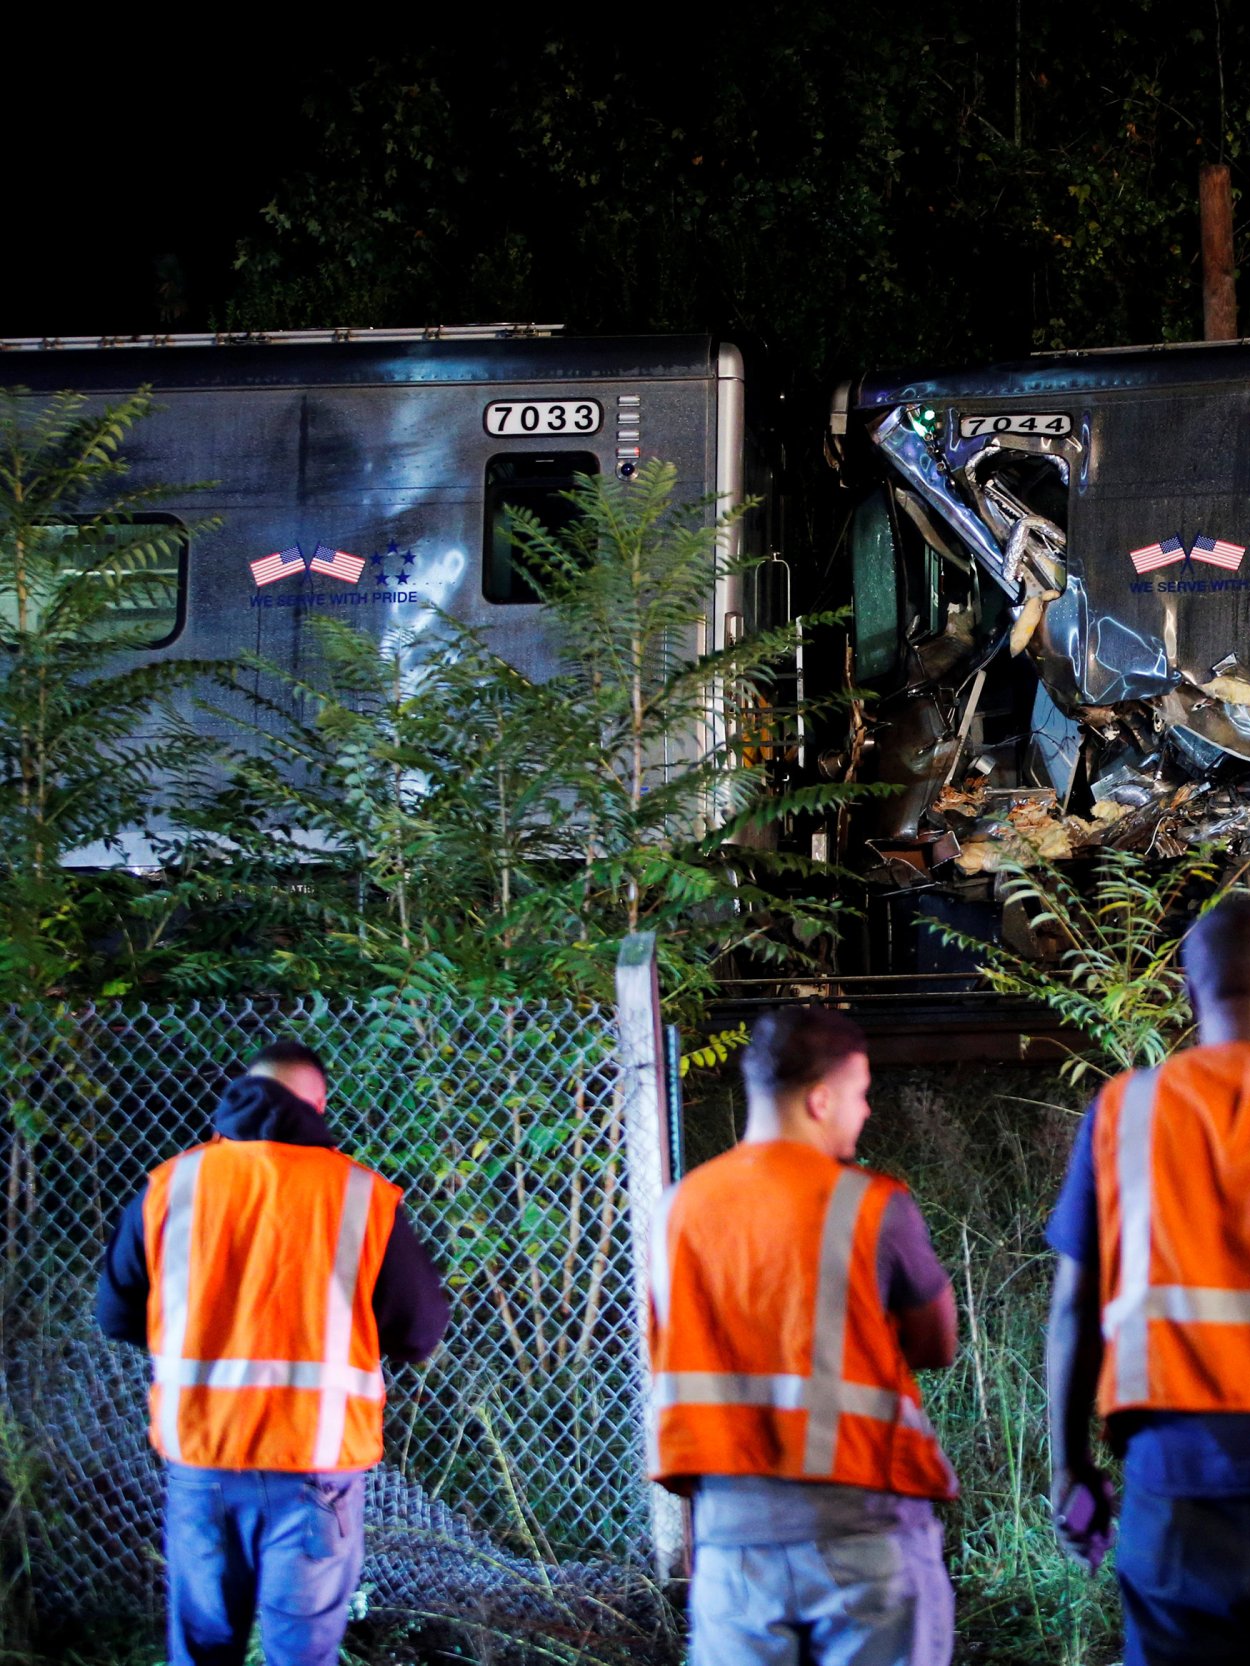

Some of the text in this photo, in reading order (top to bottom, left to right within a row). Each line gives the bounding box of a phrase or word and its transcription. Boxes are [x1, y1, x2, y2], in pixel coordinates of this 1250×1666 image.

[494, 404, 594, 432] 7033
[968, 416, 1065, 436] 7044
[1129, 581, 1154, 594] WE
[1157, 580, 1206, 593] SERVE
[1210, 578, 1250, 592] WITH
[249, 590, 418, 608] WE SERVE WITH PRIDE
